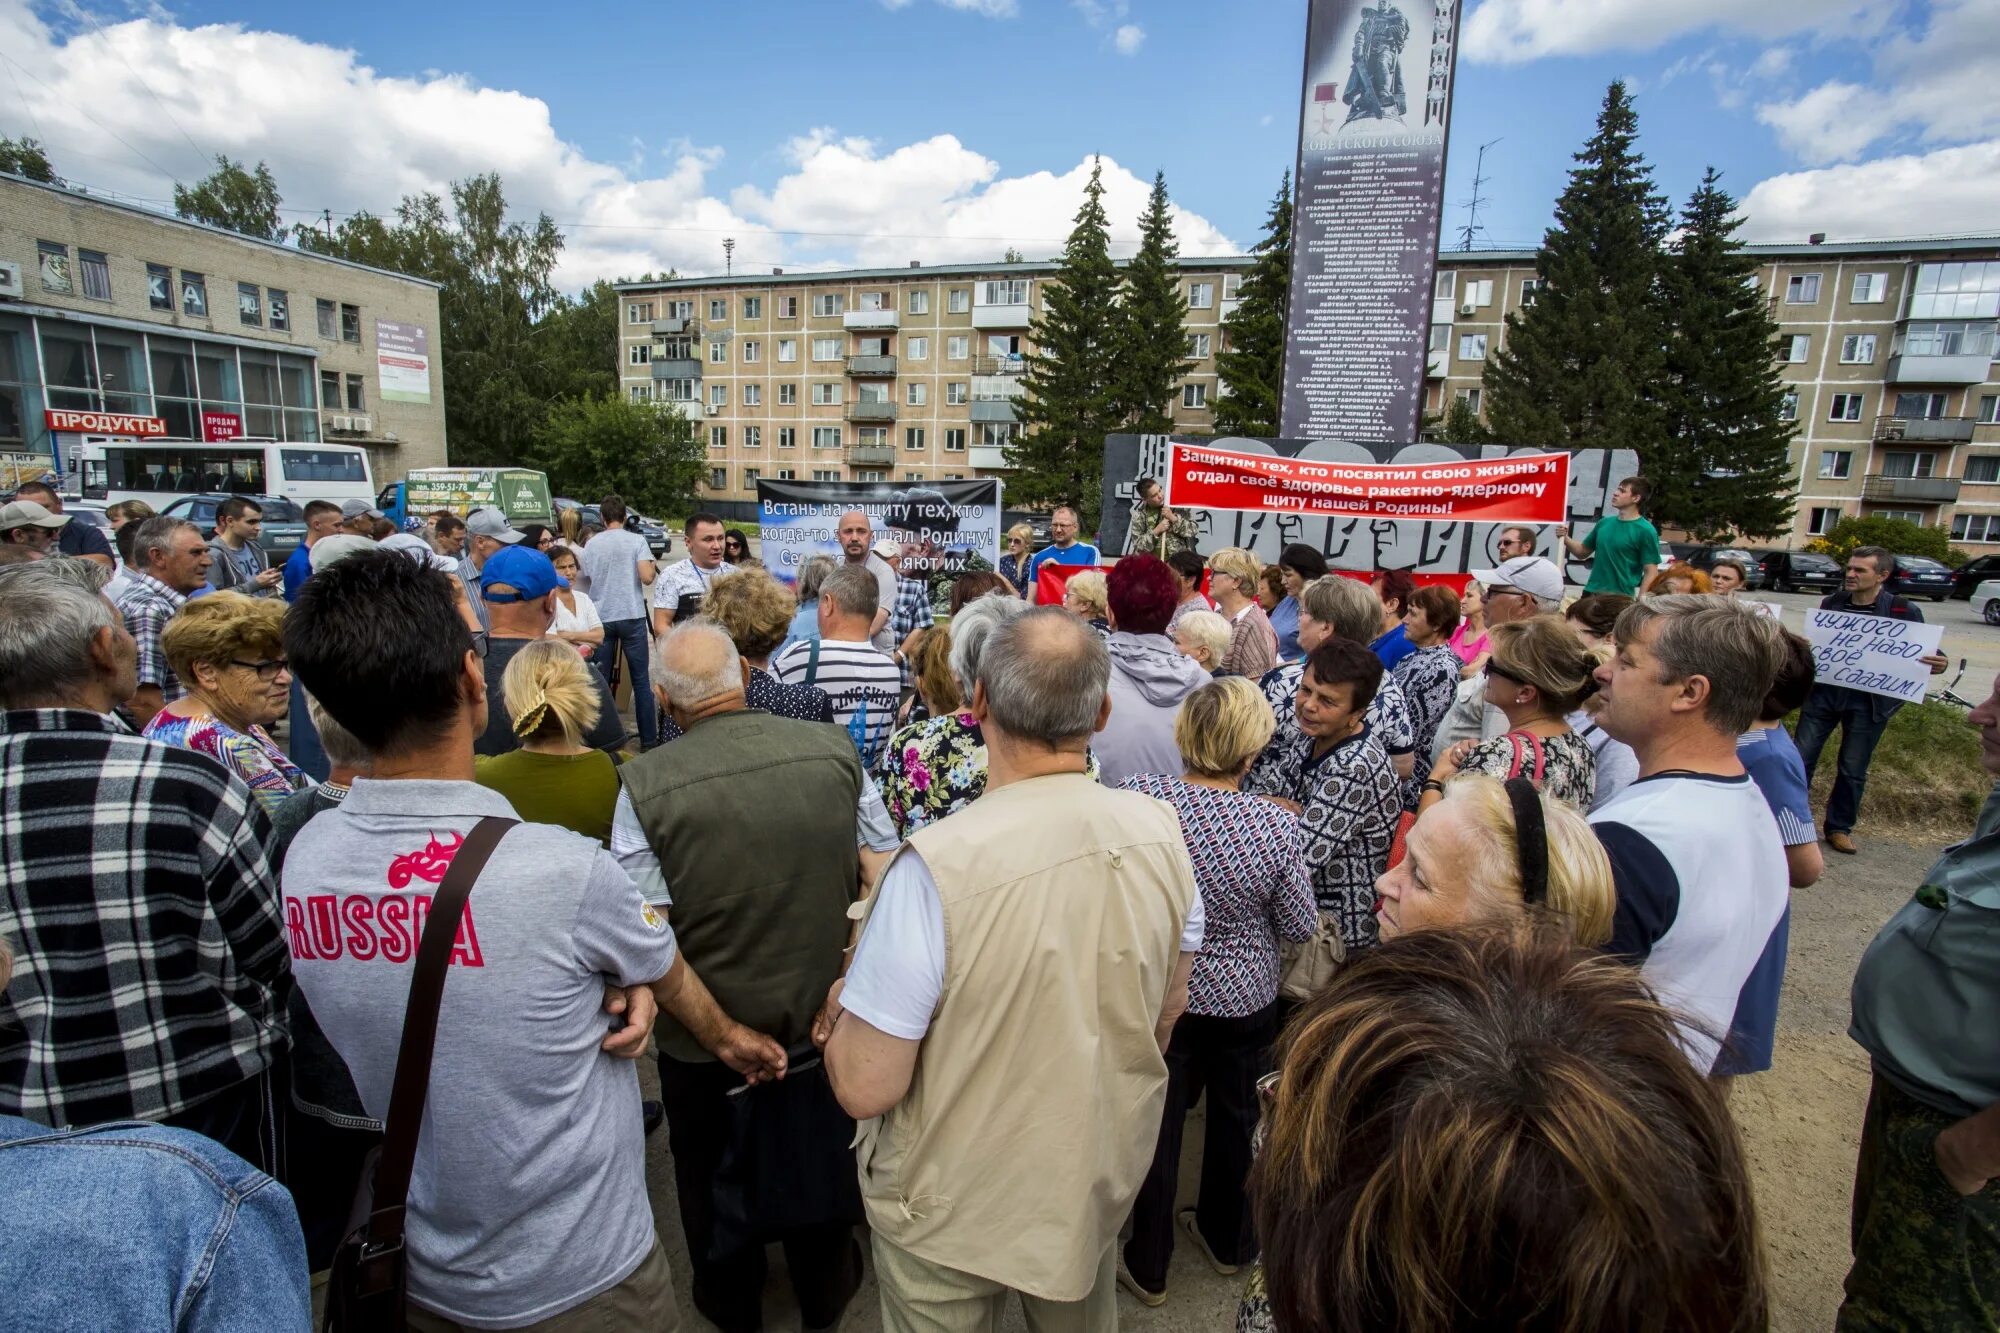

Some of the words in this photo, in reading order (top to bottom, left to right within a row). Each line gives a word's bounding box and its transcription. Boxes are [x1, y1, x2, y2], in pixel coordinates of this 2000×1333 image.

[1302, 137, 1388, 151] СОВЕТСКОГО
[1392, 135, 1442, 147] СОЮЗА
[52, 412, 165, 433] ПРОДУКТЫ
[207, 416, 237, 426] ПРОДАМ
[212, 426, 233, 435] СДАМ
[1180, 448, 1256, 468] Защитим
[1261, 461, 1293, 475] тех,
[1299, 465, 1328, 477] кто
[1333, 467, 1416, 480] посвятил
[1421, 467, 1471, 480] свою
[1476, 461, 1539, 477] жизнь
[1545, 461, 1557, 473] и
[431, 482, 468, 491] 359-51-78
[1186, 470, 1235, 485] отдал
[1239, 475, 1277, 488] своё
[1281, 479, 1363, 495] здоровье
[1368, 483, 1547, 499] ракетно-ядерному
[512, 501, 542, 509] 359-51-78
[763, 499, 817, 517] Встань
[822, 503, 842, 516] на
[1263, 494, 1307, 510] щиту
[1312, 498, 1369, 511] нашей
[1375, 501, 1453, 515] Родины!
[761, 527, 829, 544] когда-то
[920, 527, 993, 549] Родину!
[945, 558, 966, 571] их
[286, 894, 485, 967] RUSSIA
